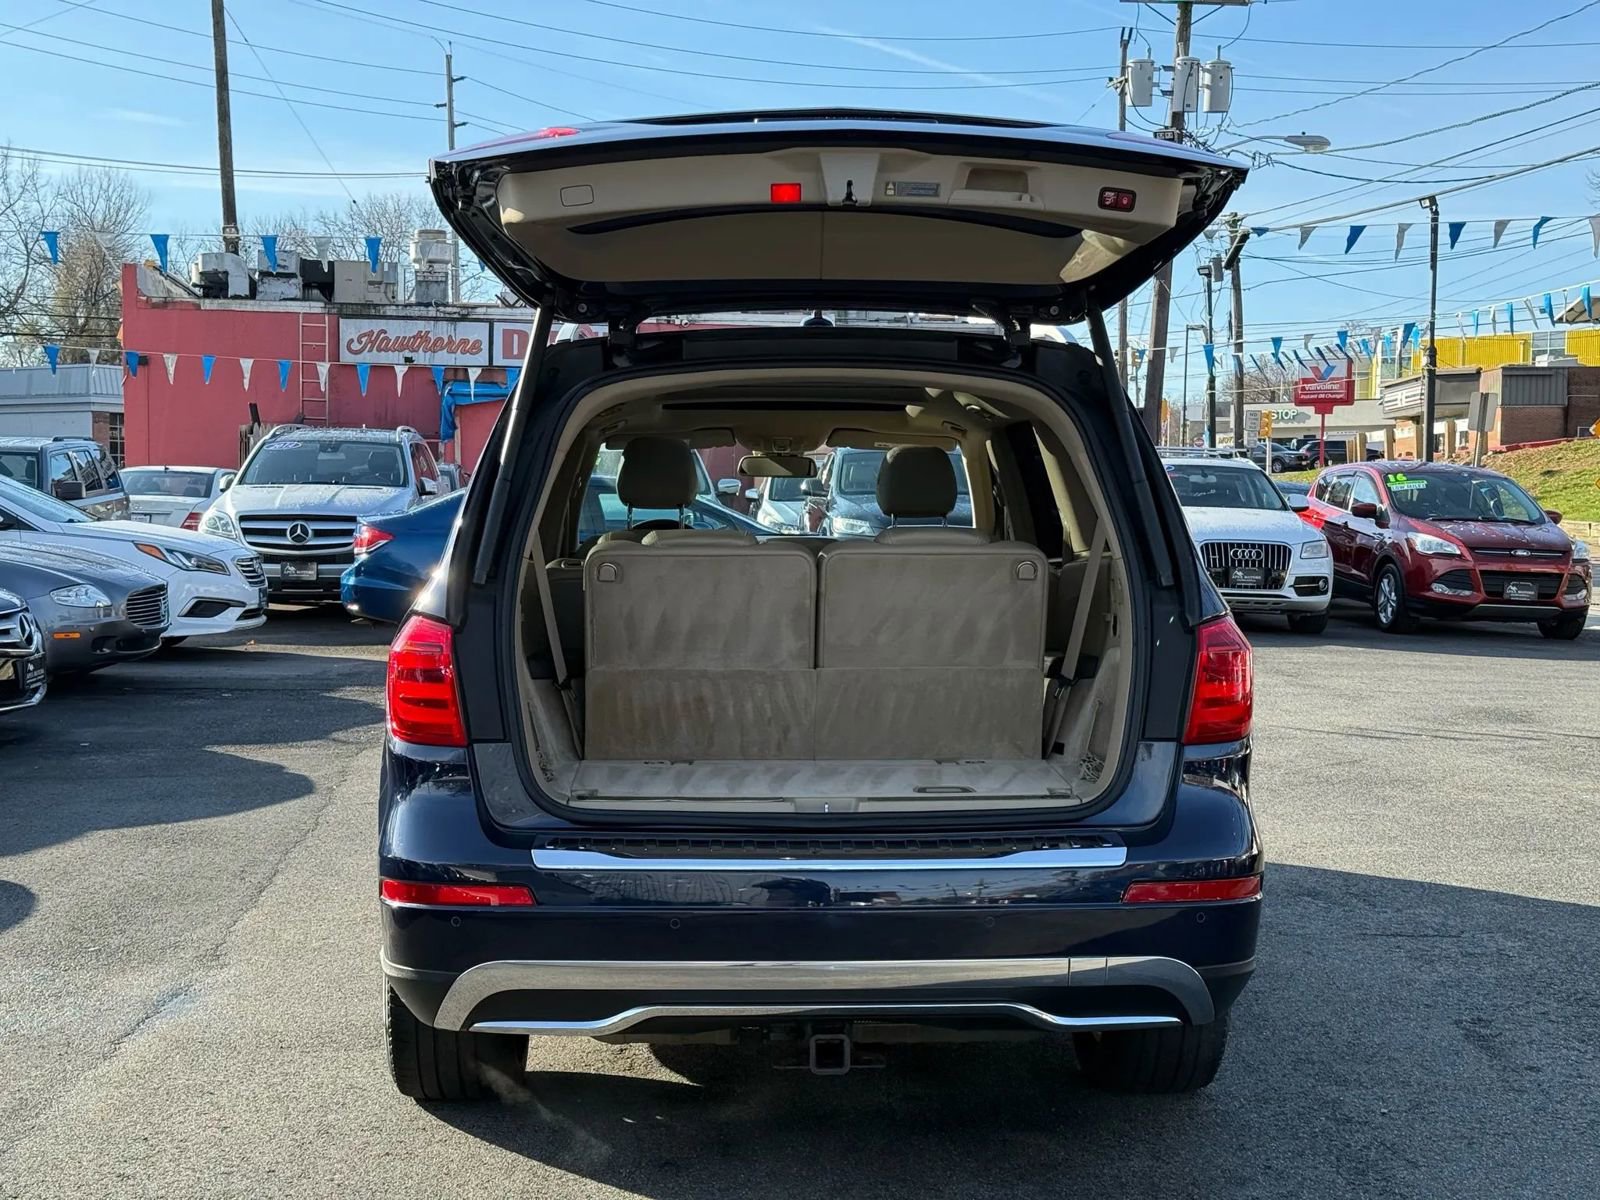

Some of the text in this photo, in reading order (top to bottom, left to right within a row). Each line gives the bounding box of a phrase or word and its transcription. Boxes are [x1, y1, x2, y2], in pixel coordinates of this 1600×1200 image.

[346, 328, 483, 355] Hawthorne
[1305, 383, 1340, 391] Valvoline
[1271, 409, 1298, 420] STOP
[1388, 473, 1407, 482] 16
